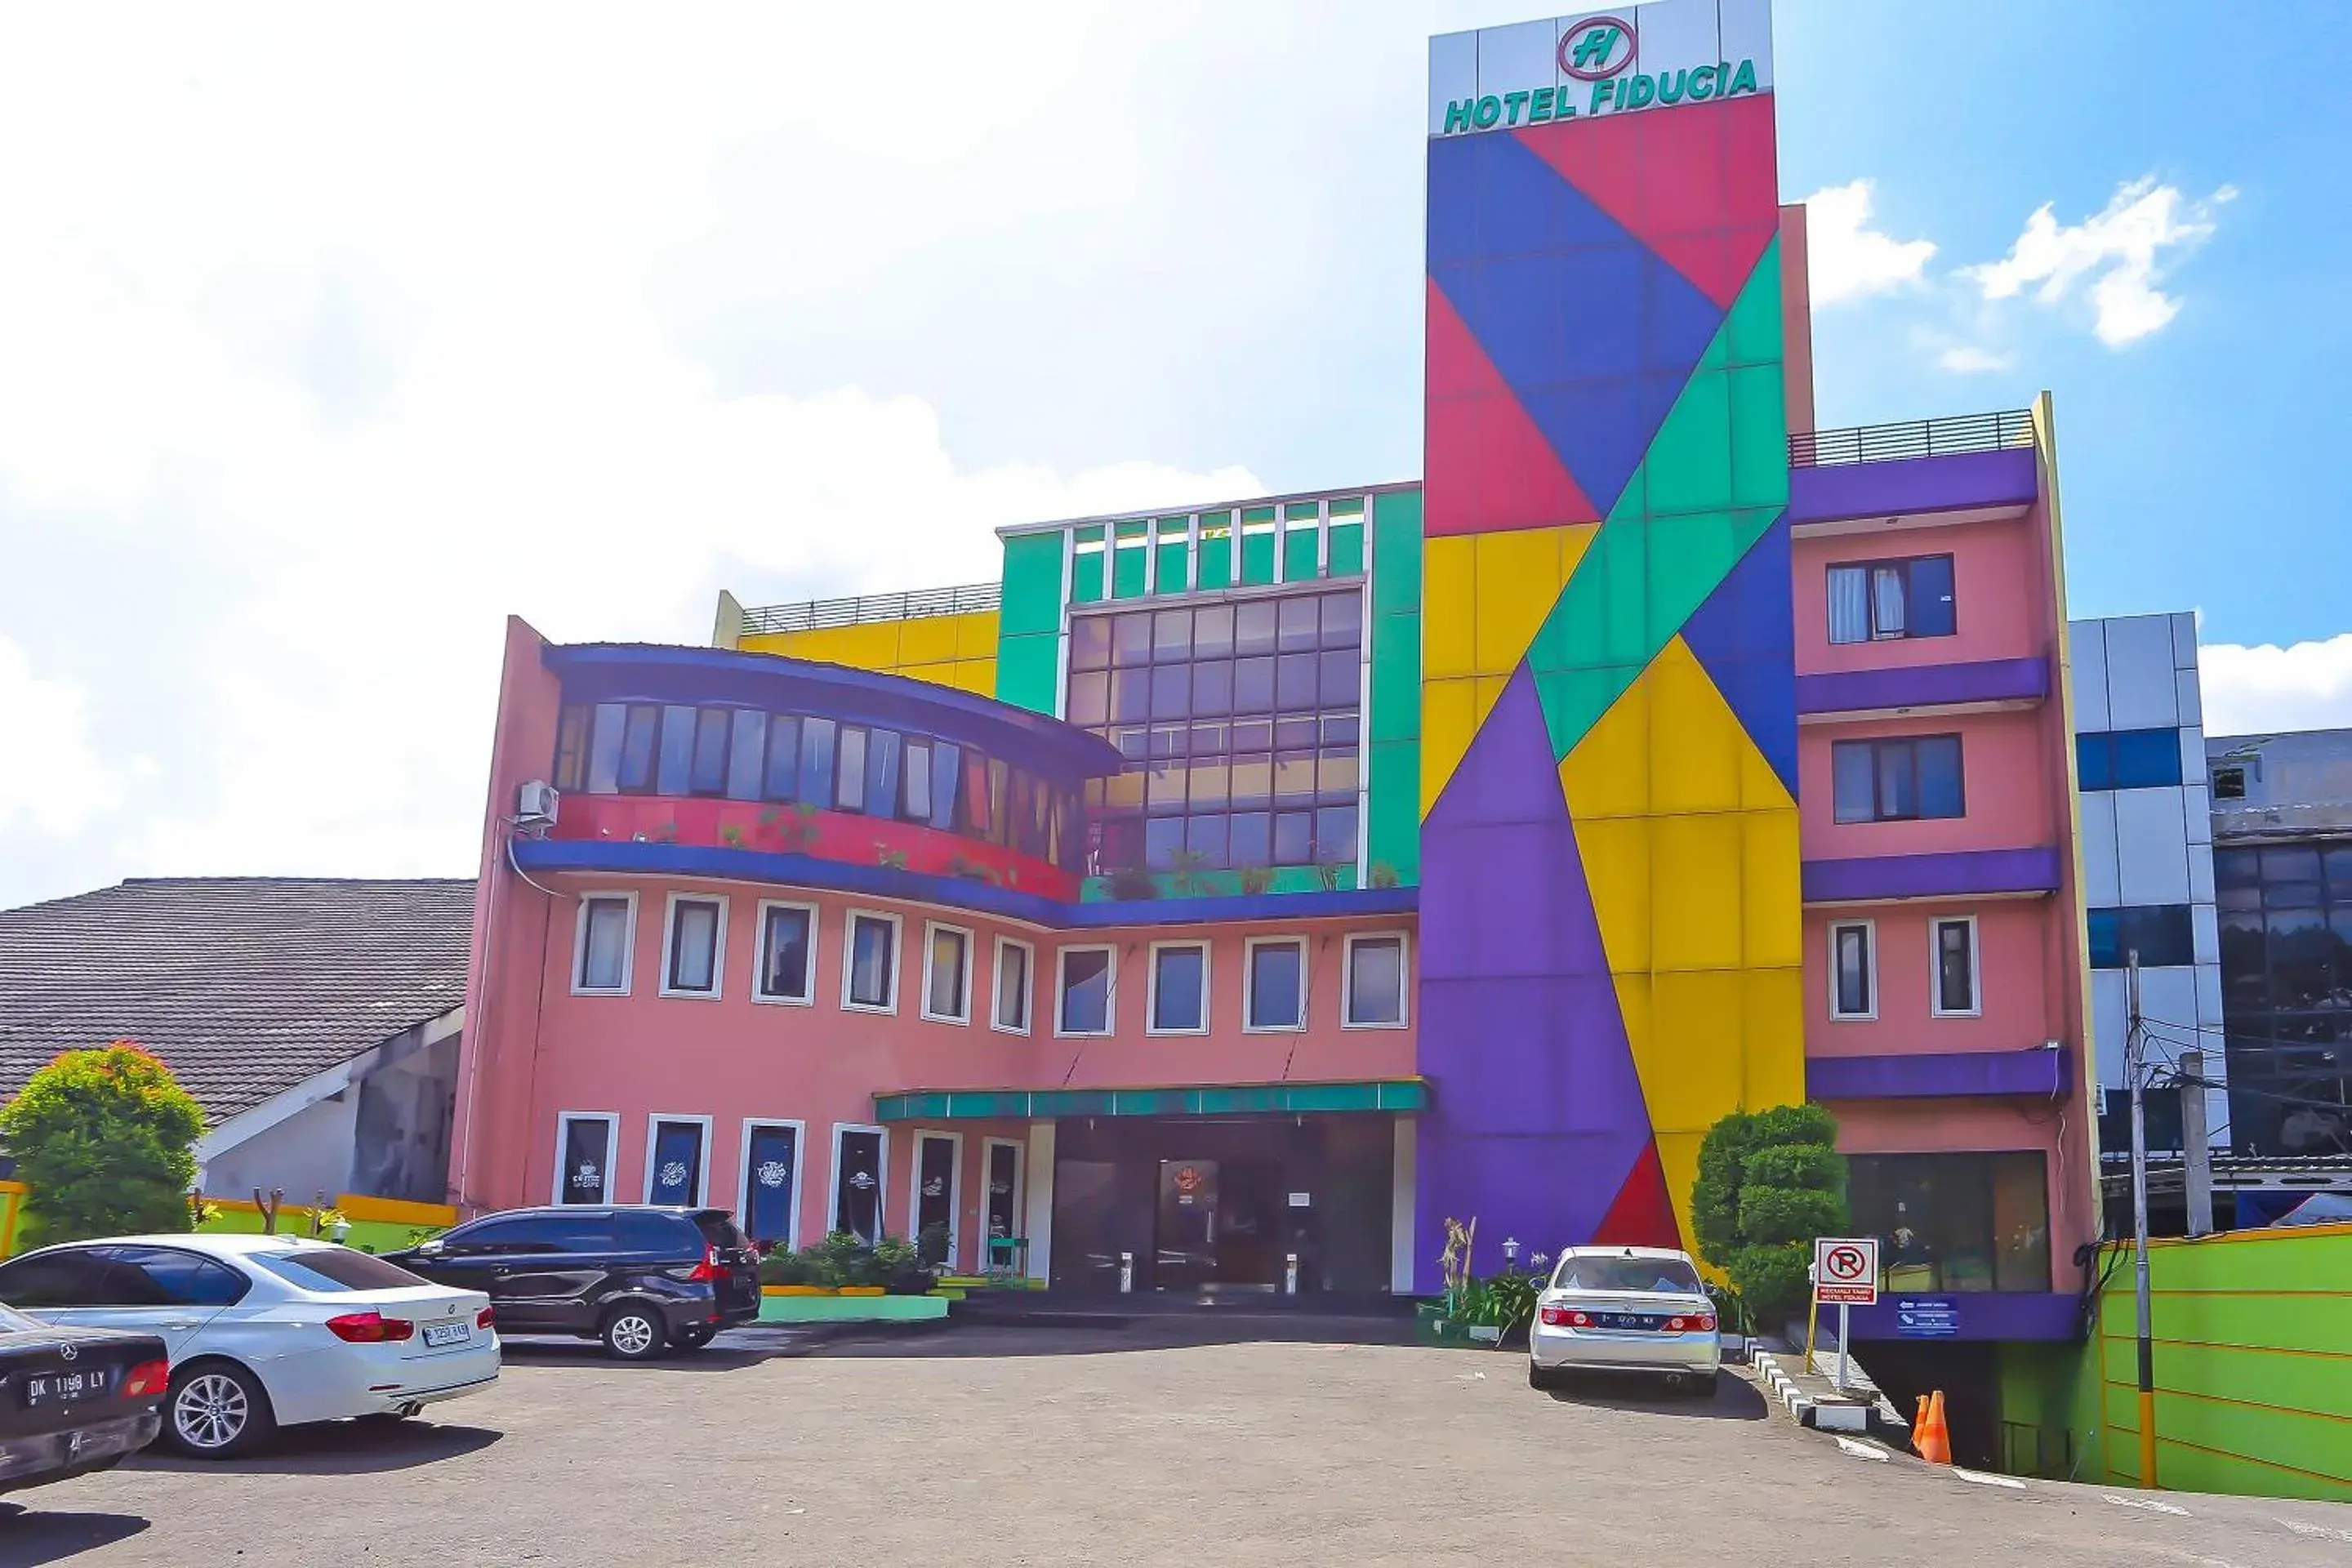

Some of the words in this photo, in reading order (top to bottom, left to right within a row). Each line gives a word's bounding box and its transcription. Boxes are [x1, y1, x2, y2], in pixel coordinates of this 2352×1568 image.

[1443, 85, 1576, 134] HOTEL
[1589, 59, 1757, 115] FIDUCIA
[30, 1379, 47, 1396] DK
[90, 1371, 105, 1388] LY
